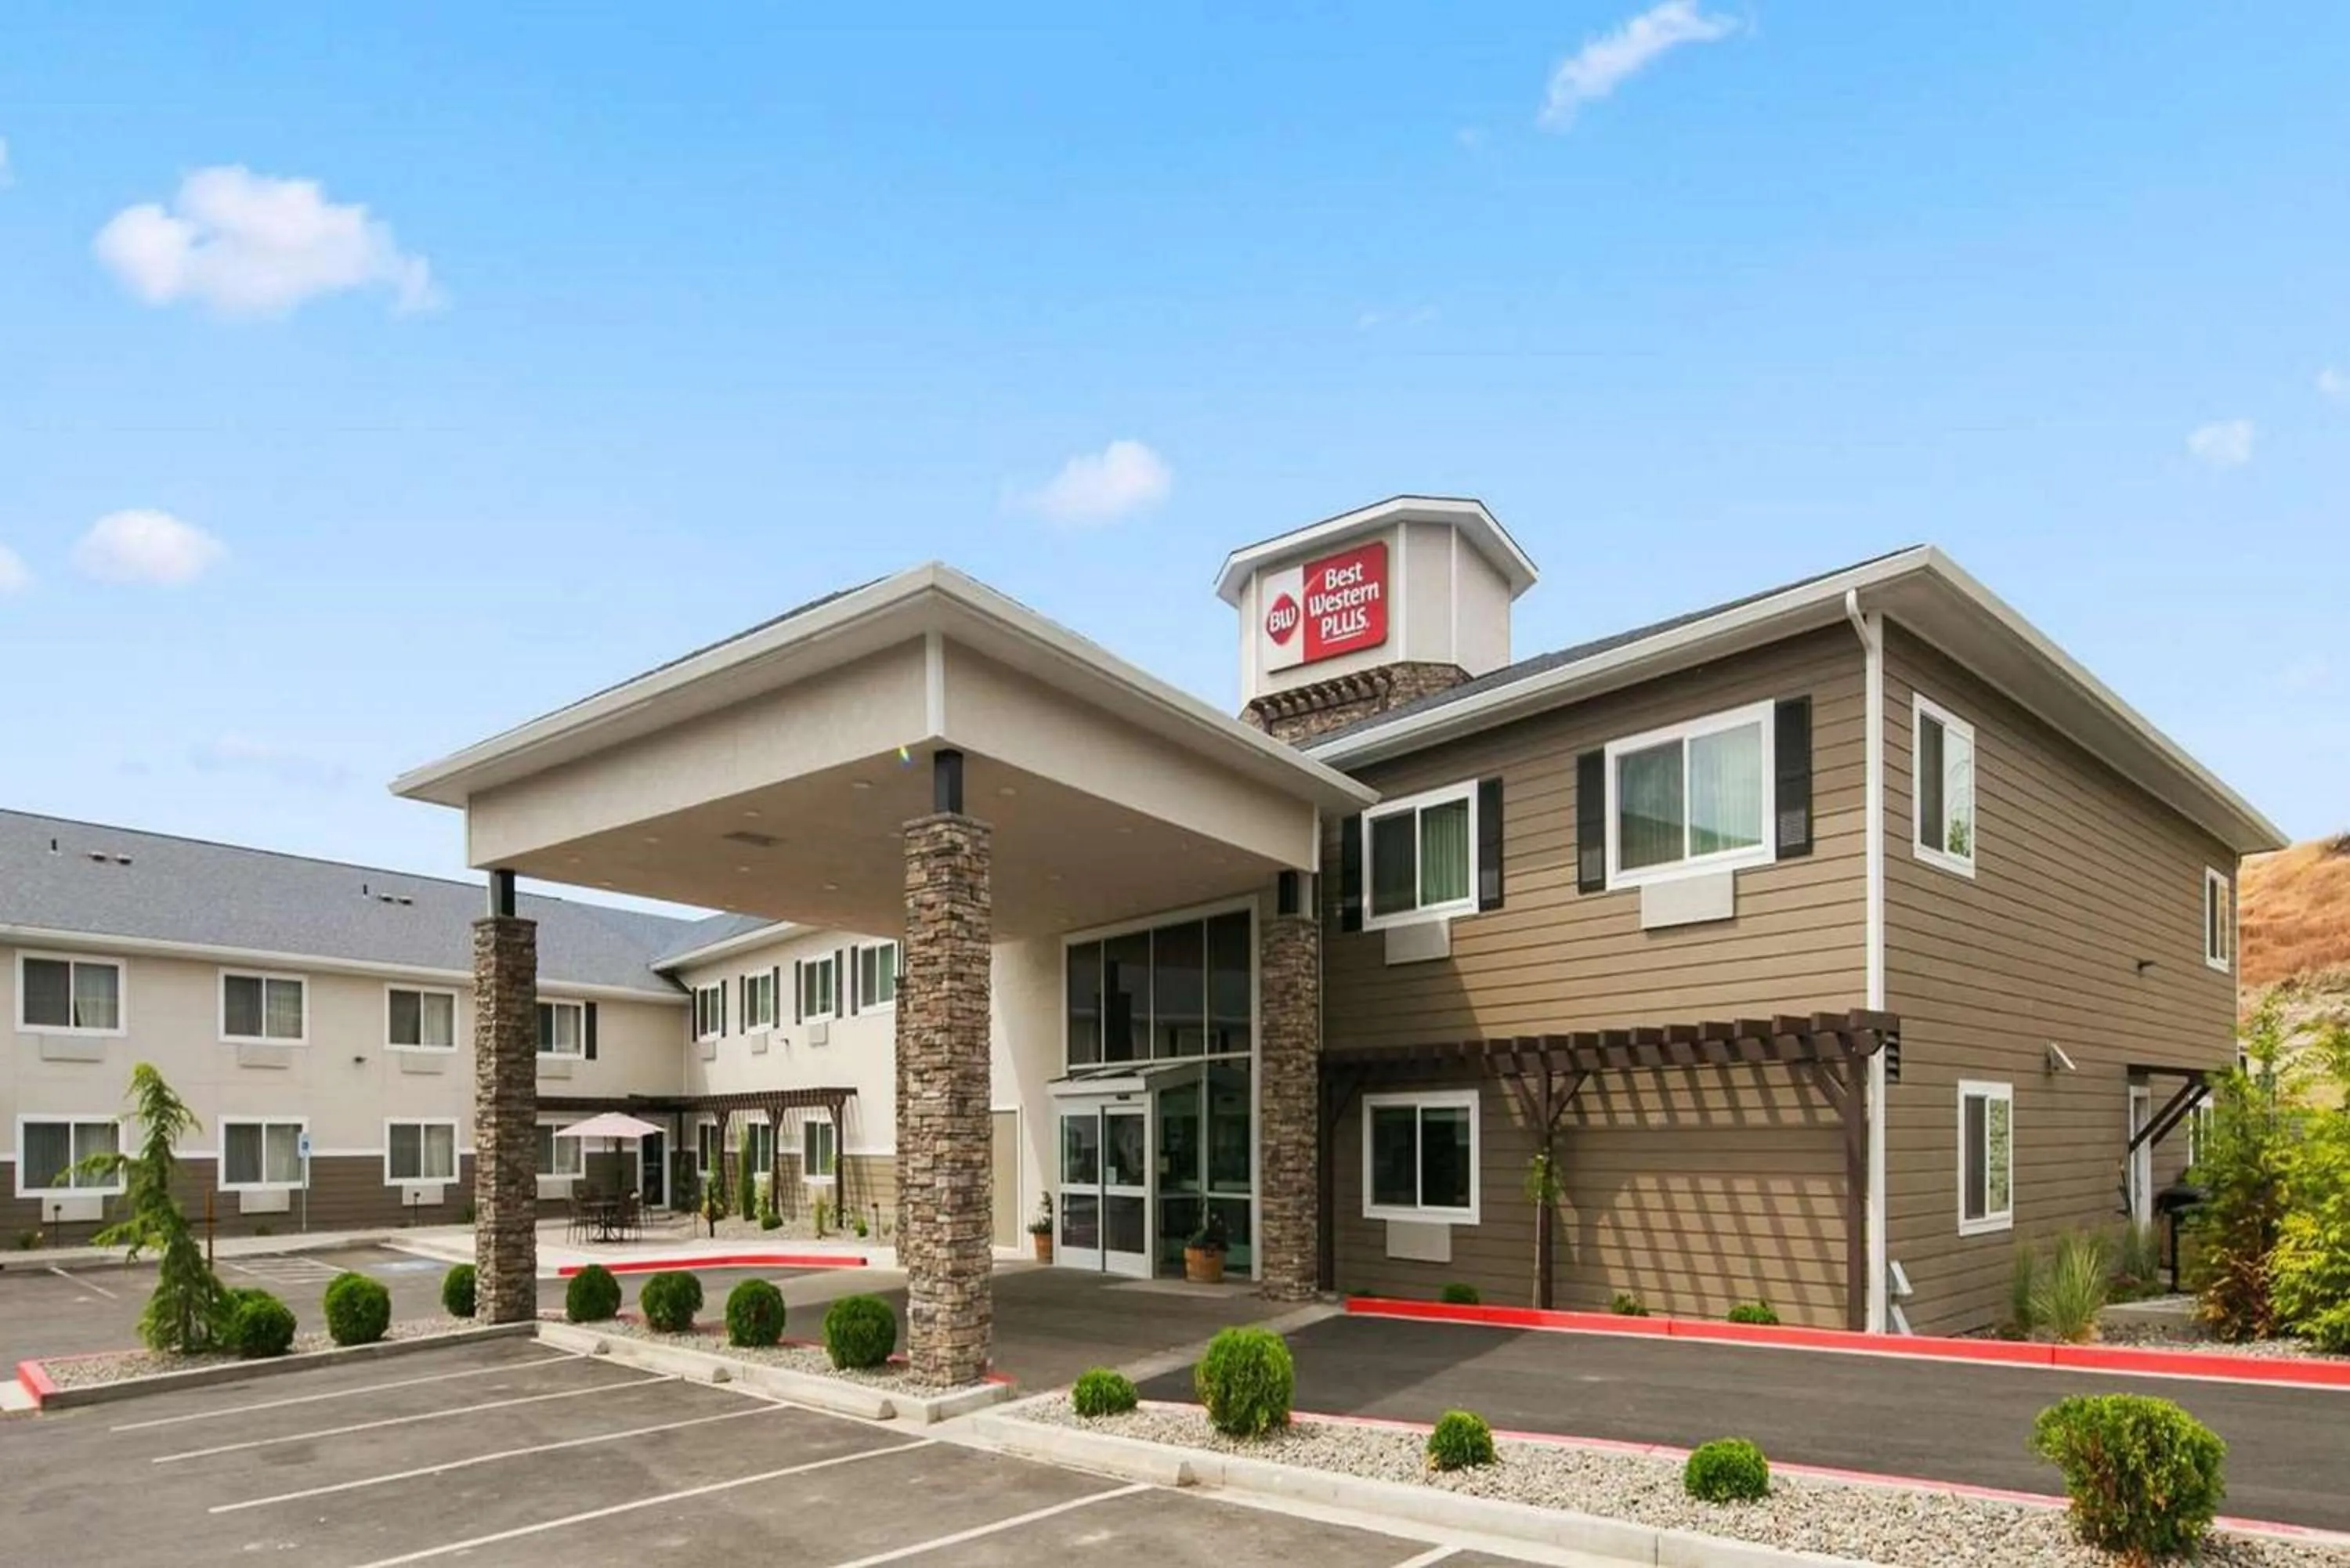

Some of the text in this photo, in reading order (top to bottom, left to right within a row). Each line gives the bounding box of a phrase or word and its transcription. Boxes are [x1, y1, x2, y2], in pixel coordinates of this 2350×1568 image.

[1325, 562, 1363, 591] Best
[1308, 581, 1379, 617] Western
[1269, 606, 1296, 633] BW
